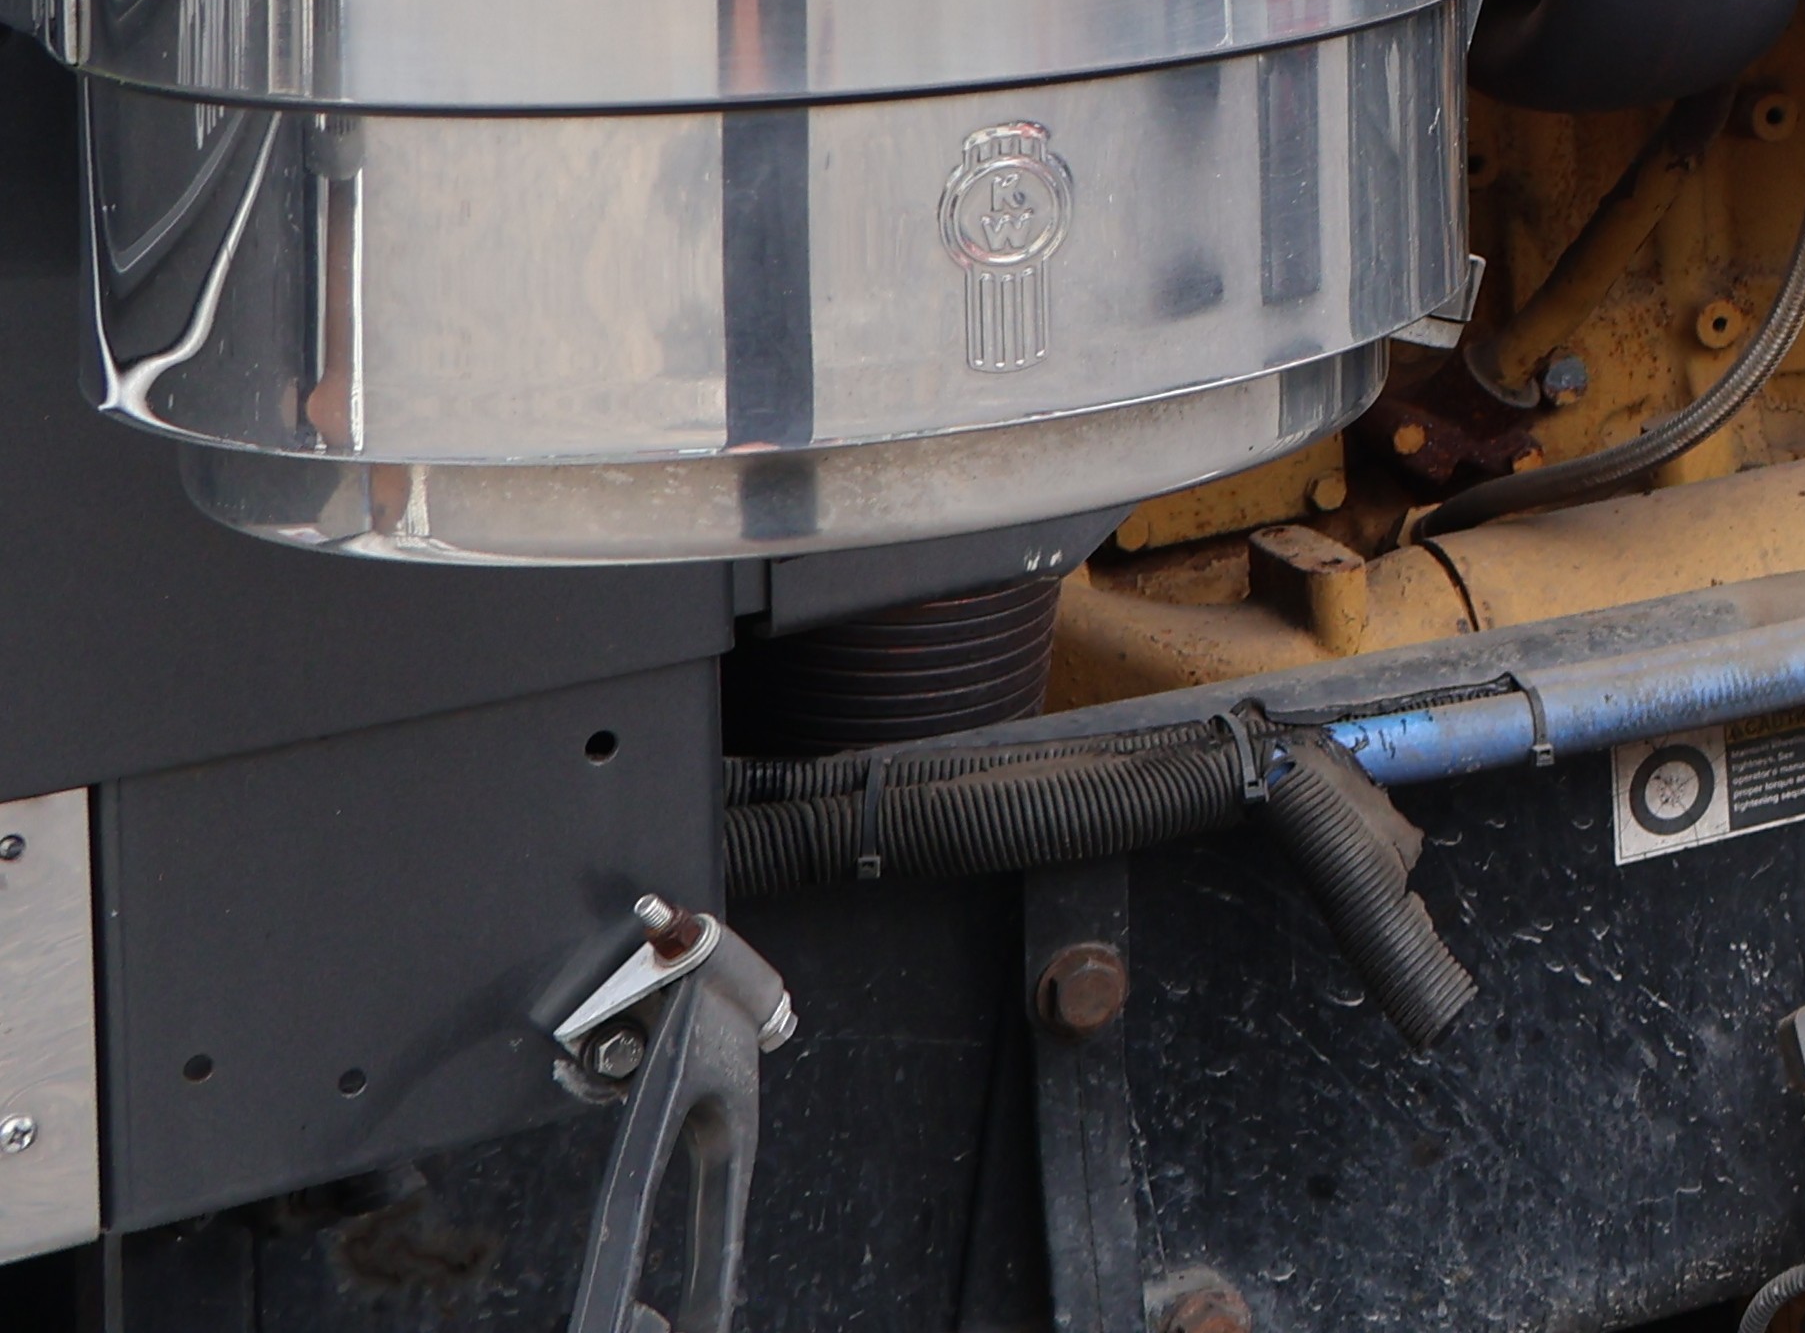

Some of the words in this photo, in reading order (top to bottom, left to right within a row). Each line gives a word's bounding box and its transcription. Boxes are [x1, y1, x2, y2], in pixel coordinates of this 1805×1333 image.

[1777, 751, 1795, 761] See
[1732, 767, 1778, 785] operator's
[1733, 785, 1762, 800] proper
[1764, 777, 1794, 791] torque
[1733, 792, 1779, 812] tightening
